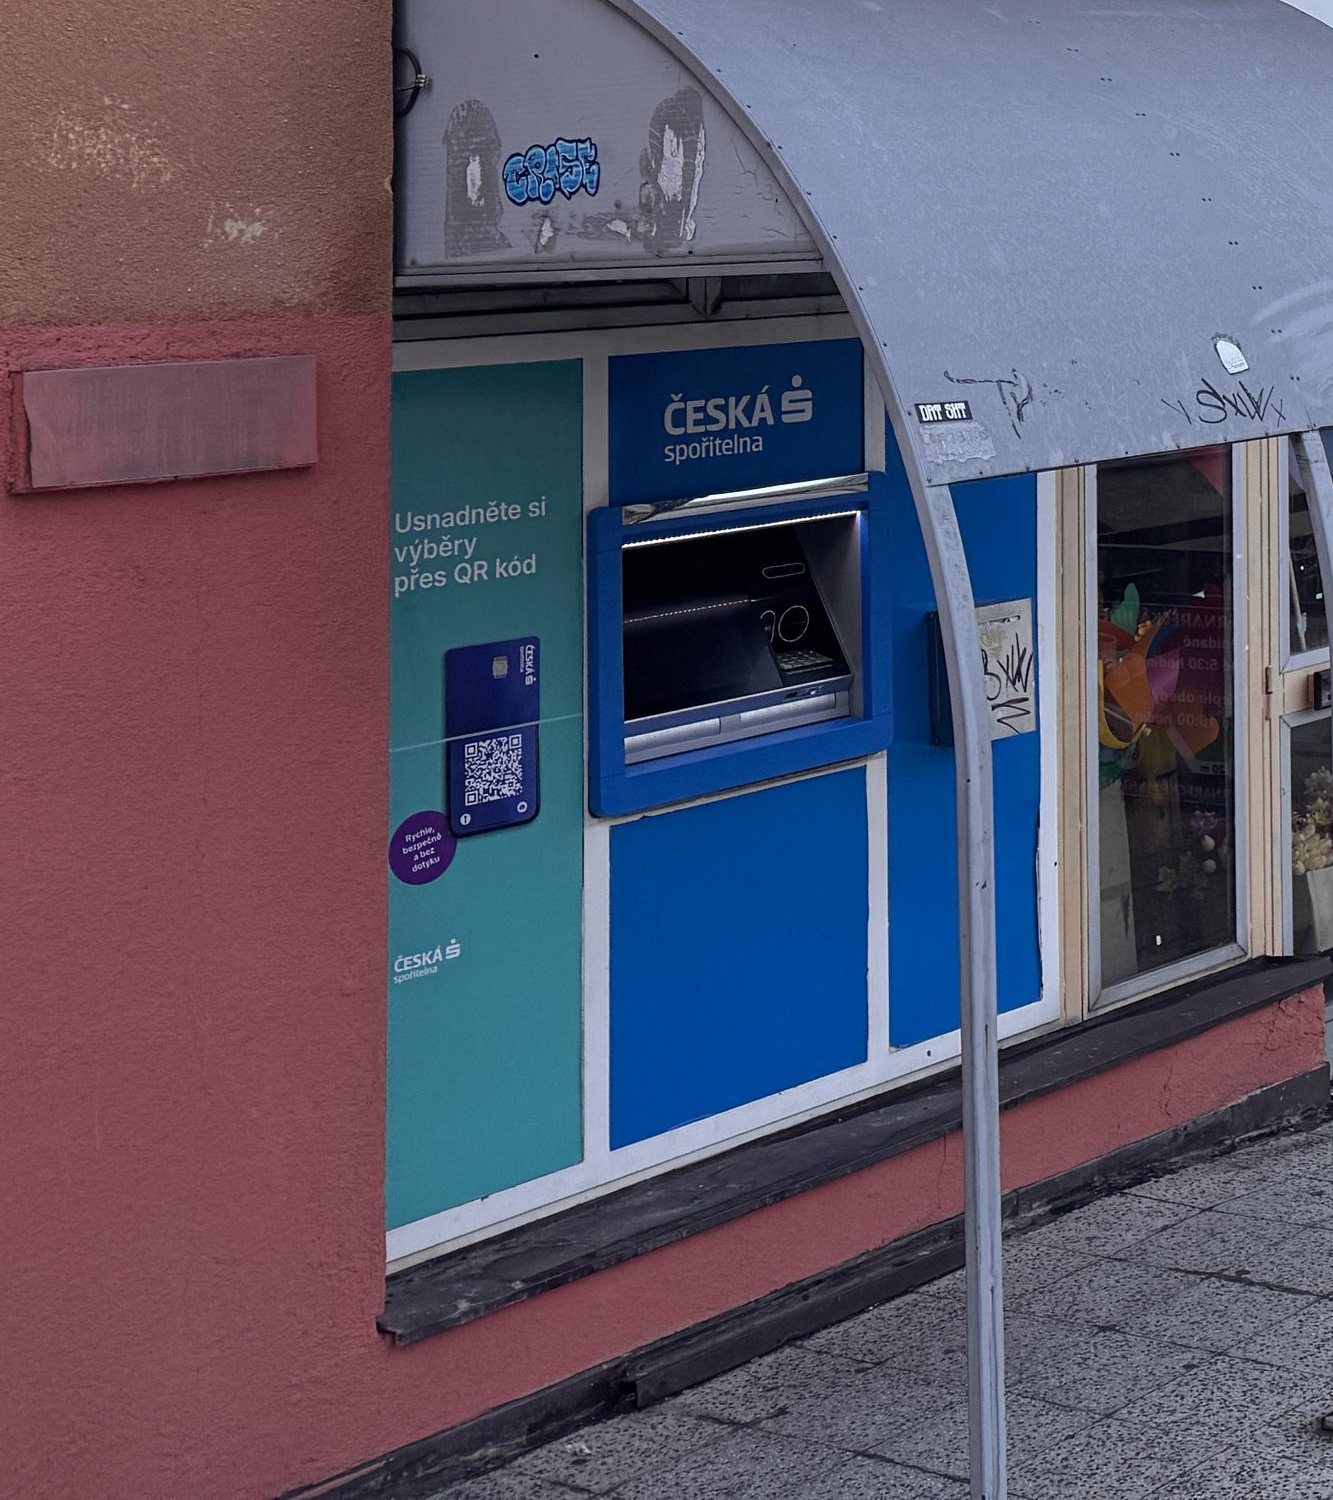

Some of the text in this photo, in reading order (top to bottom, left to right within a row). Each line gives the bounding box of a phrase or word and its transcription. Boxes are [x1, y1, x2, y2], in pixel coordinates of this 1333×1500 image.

[664, 385, 774, 435] ČESKÁ
[664, 434, 763, 465] spořitelna
[394, 496, 547, 534] Usnadněte si
[394, 537, 477, 564] výběry
[394, 554, 537, 598] přes QR kód
[402, 832, 442, 854] bezpečně
[405, 827, 435, 842] Rychle,
[412, 856, 440, 872] dotyku
[420, 847, 436, 858] bez
[394, 945, 443, 973] ČESKÁ
